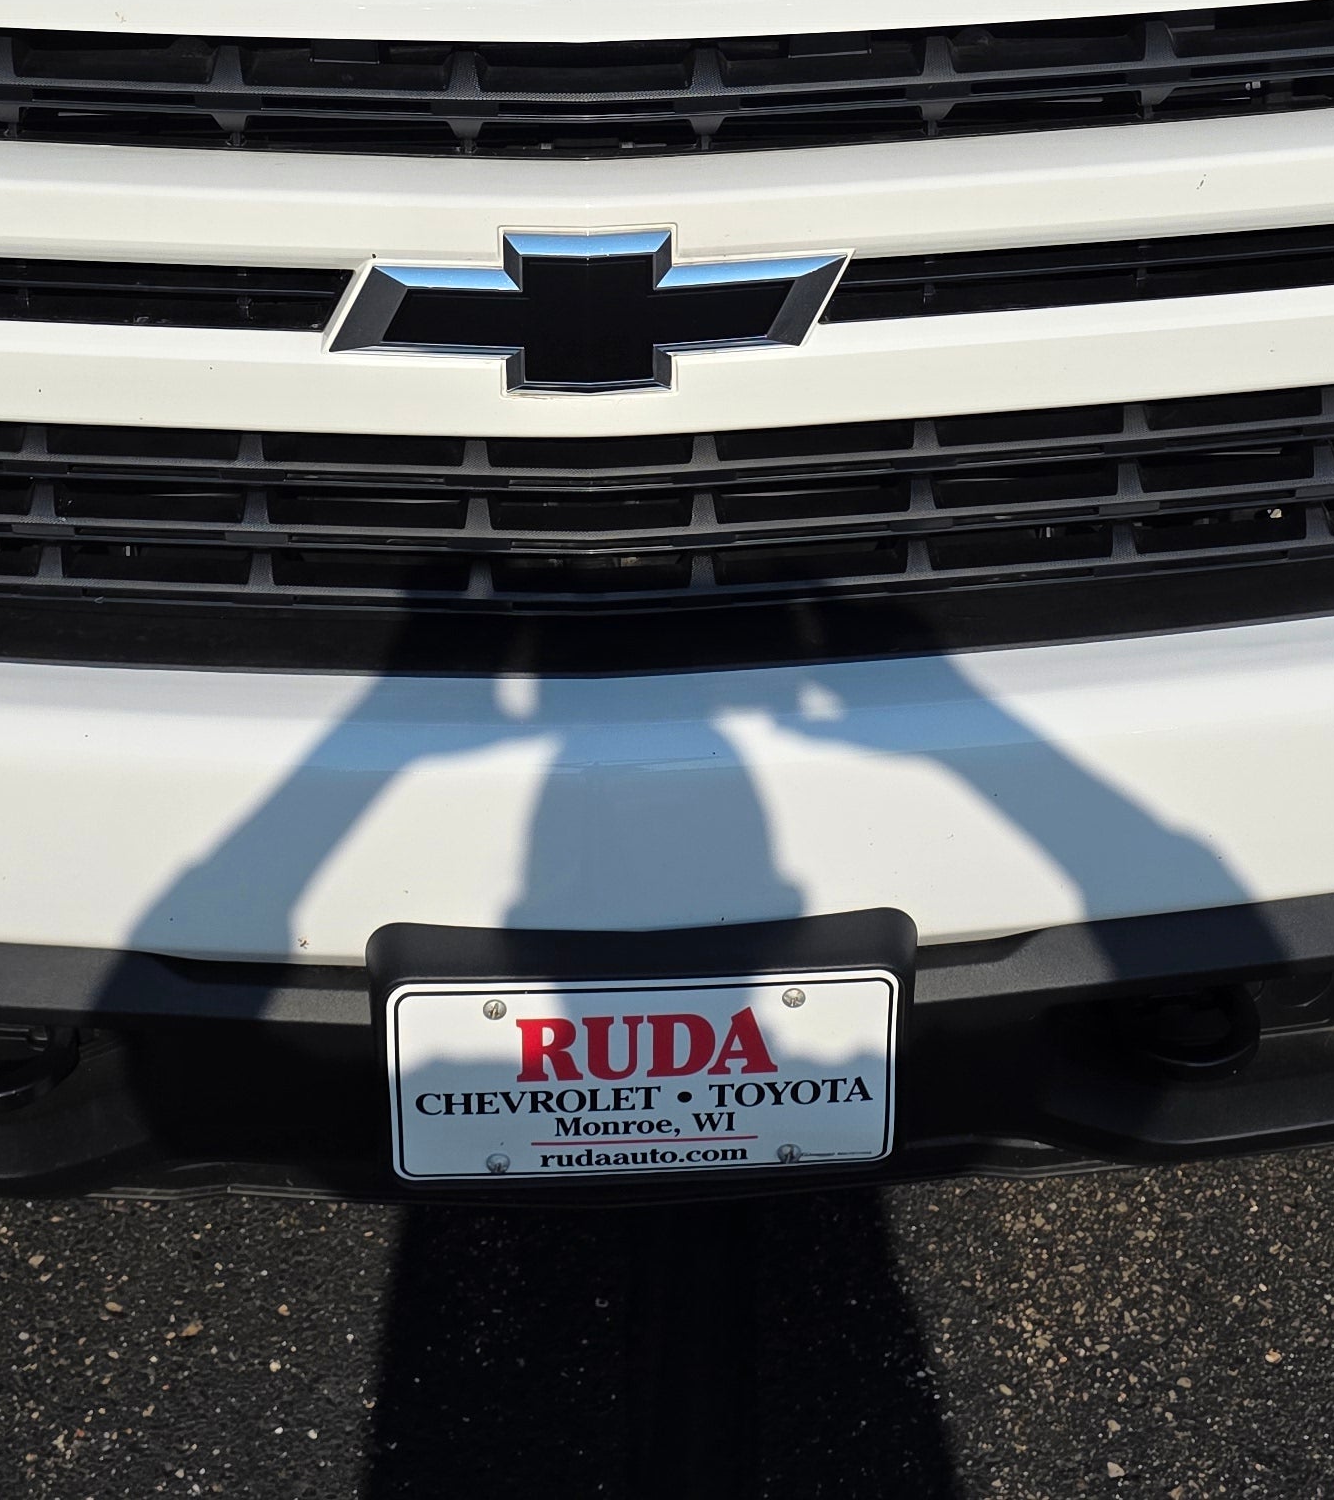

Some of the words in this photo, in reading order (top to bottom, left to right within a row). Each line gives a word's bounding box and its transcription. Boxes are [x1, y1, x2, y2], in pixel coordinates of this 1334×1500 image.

[515, 1008, 777, 1082] RUDA
[415, 1086, 661, 1116] CHEVROLET
[708, 1076, 873, 1108] TOYOTA
[554, 1116, 681, 1138] Monroe,
[692, 1112, 736, 1132] WI
[540, 1147, 748, 1168] rudaauto.com
